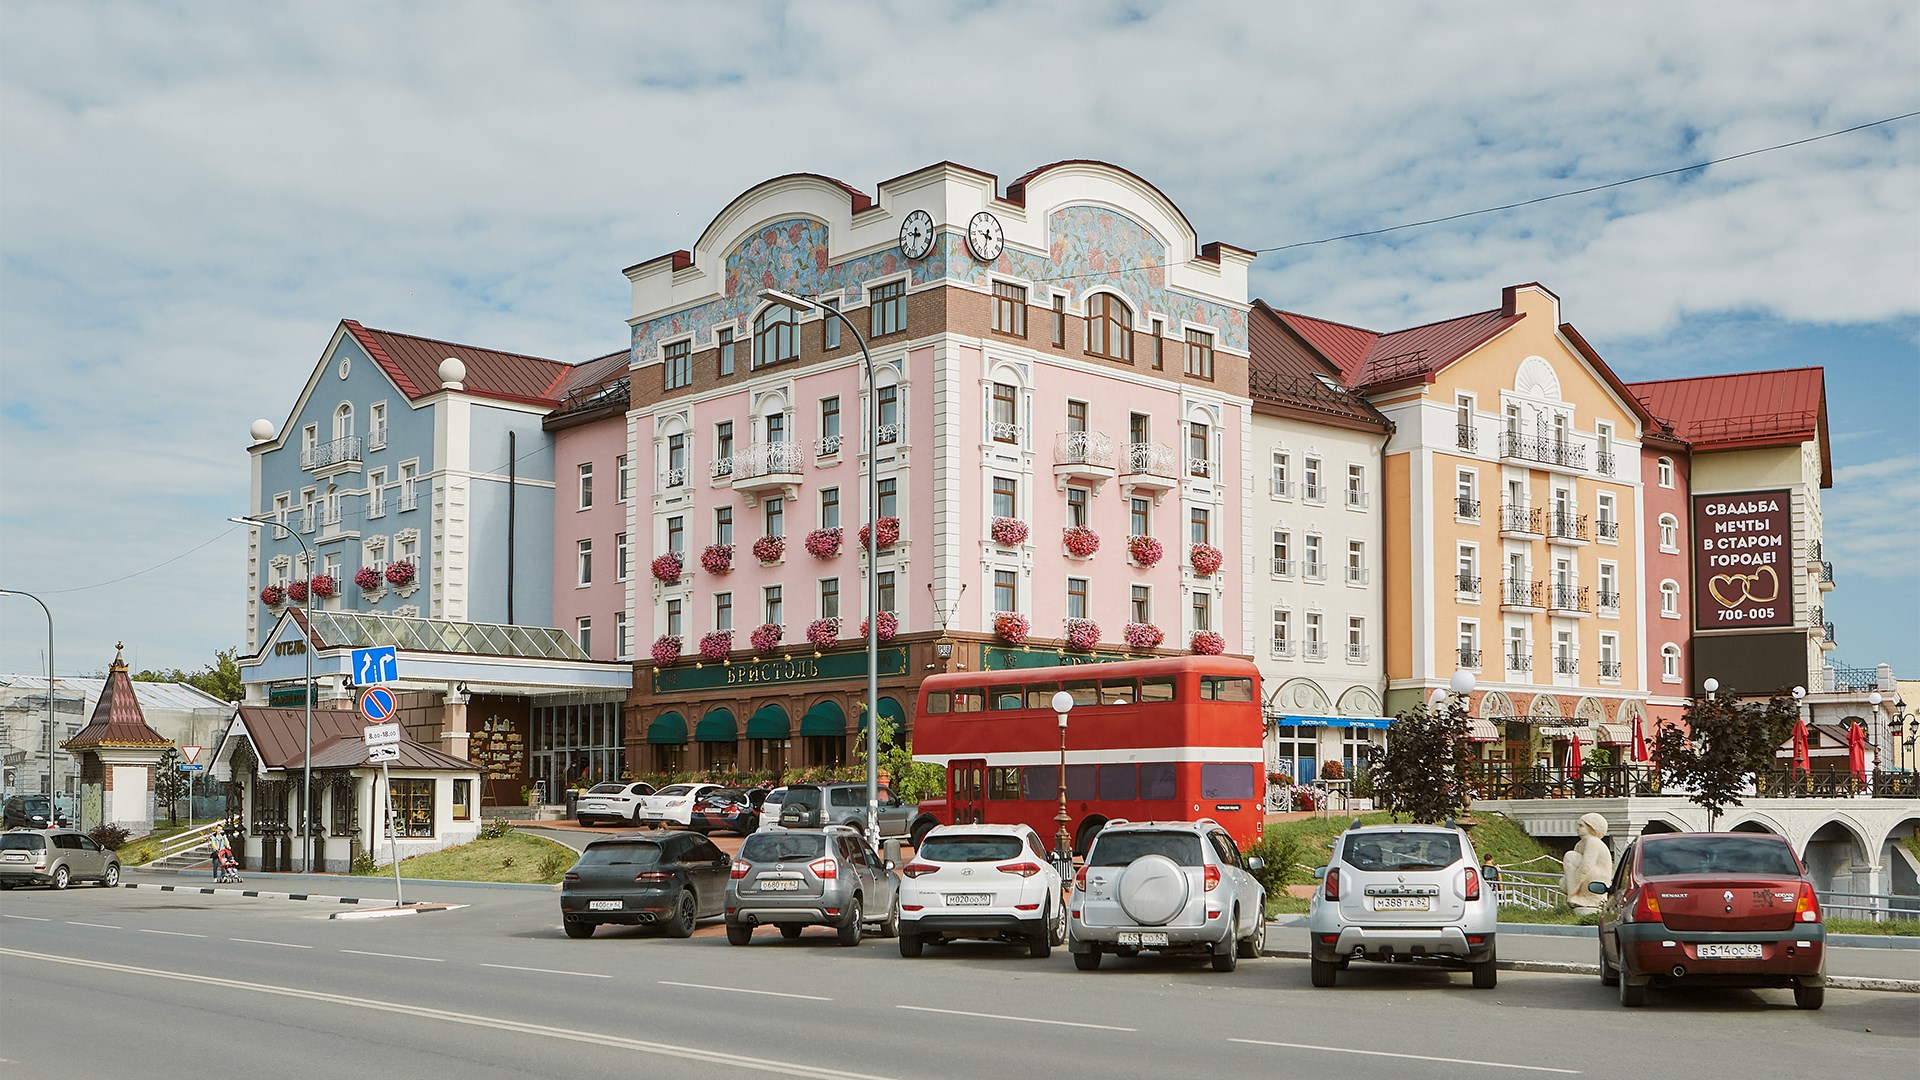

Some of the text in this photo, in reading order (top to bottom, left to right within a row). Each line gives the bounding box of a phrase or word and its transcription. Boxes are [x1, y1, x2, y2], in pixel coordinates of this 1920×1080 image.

[1705, 500, 1780, 516] СВАДЬБА
[1715, 519, 1770, 534] МЕЧТЫ
[1703, 534, 1782, 551] В СТАРОМ
[1710, 551, 1777, 567] ГОРОДЕ!
[1717, 607, 1775, 621] 700-005
[275, 639, 307, 657] ОТЕЛЬ
[727, 660, 819, 684] БРИСТОЛЬ
